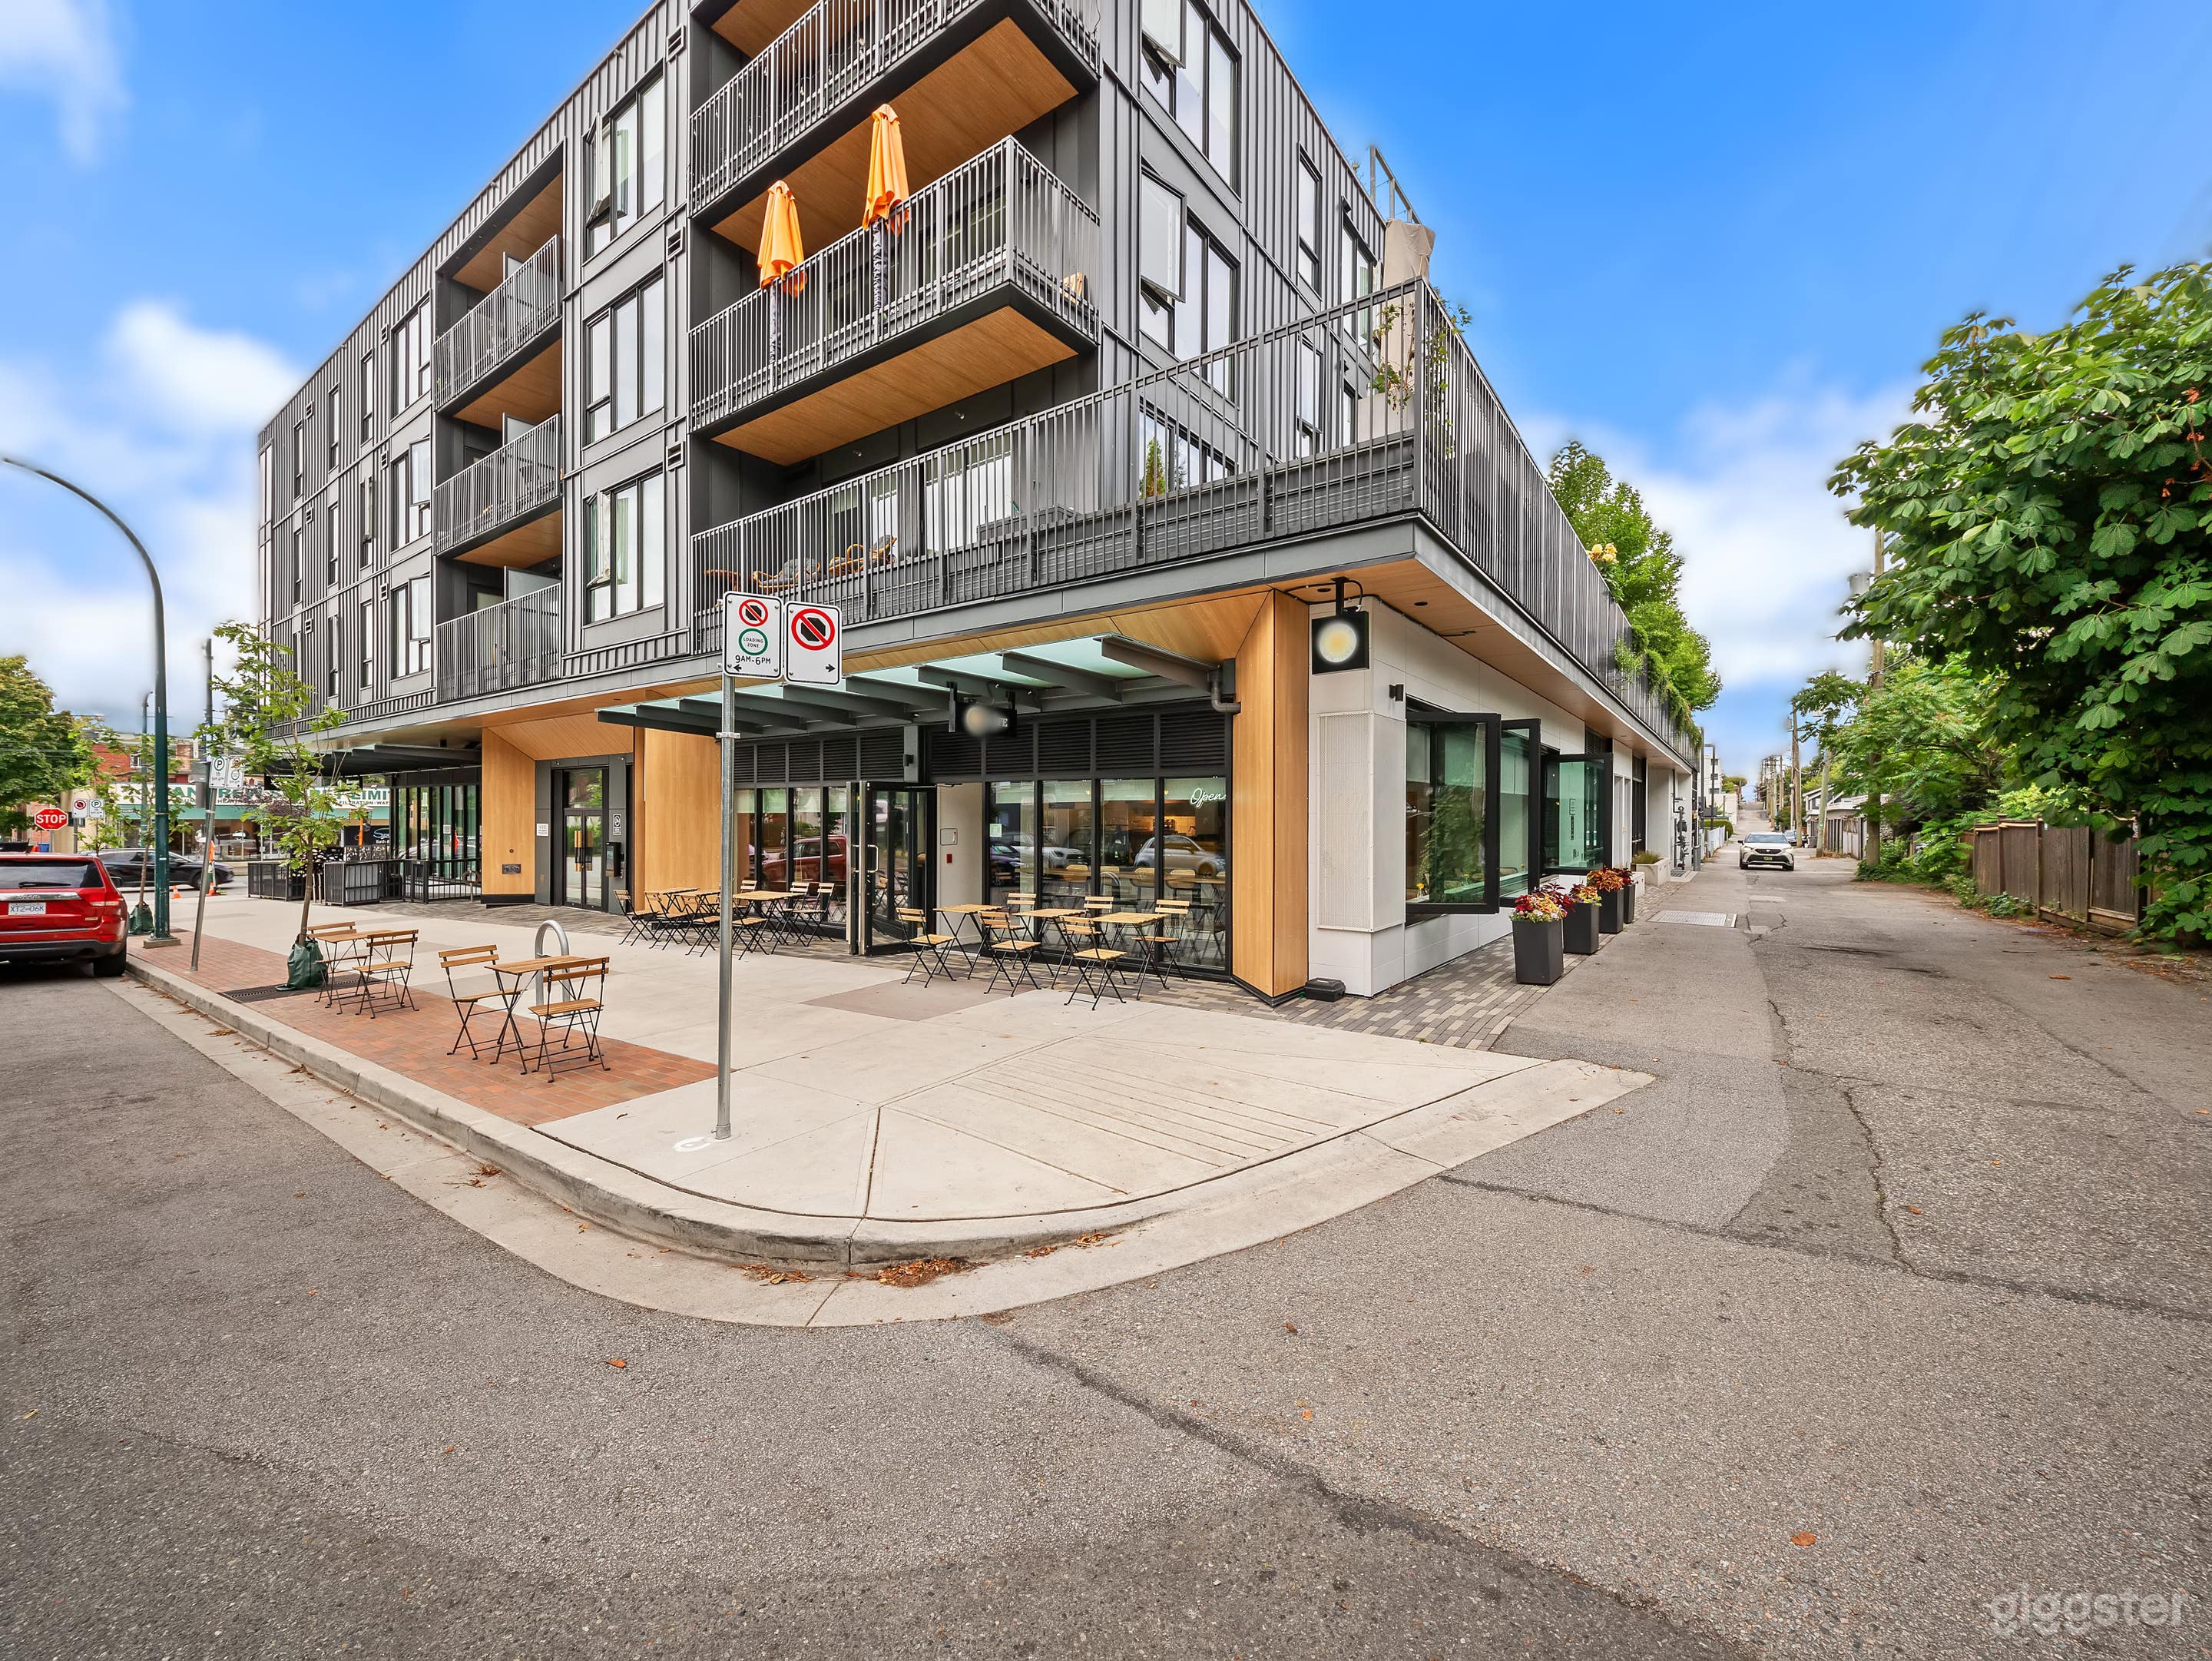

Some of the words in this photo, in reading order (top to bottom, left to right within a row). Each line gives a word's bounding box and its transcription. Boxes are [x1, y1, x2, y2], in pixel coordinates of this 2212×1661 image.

[735, 655, 771, 665] 9AM-6PM
[352, 790, 389, 800] LIMI
[1190, 787, 1227, 807] Open
[36, 814, 66, 824] STOP
